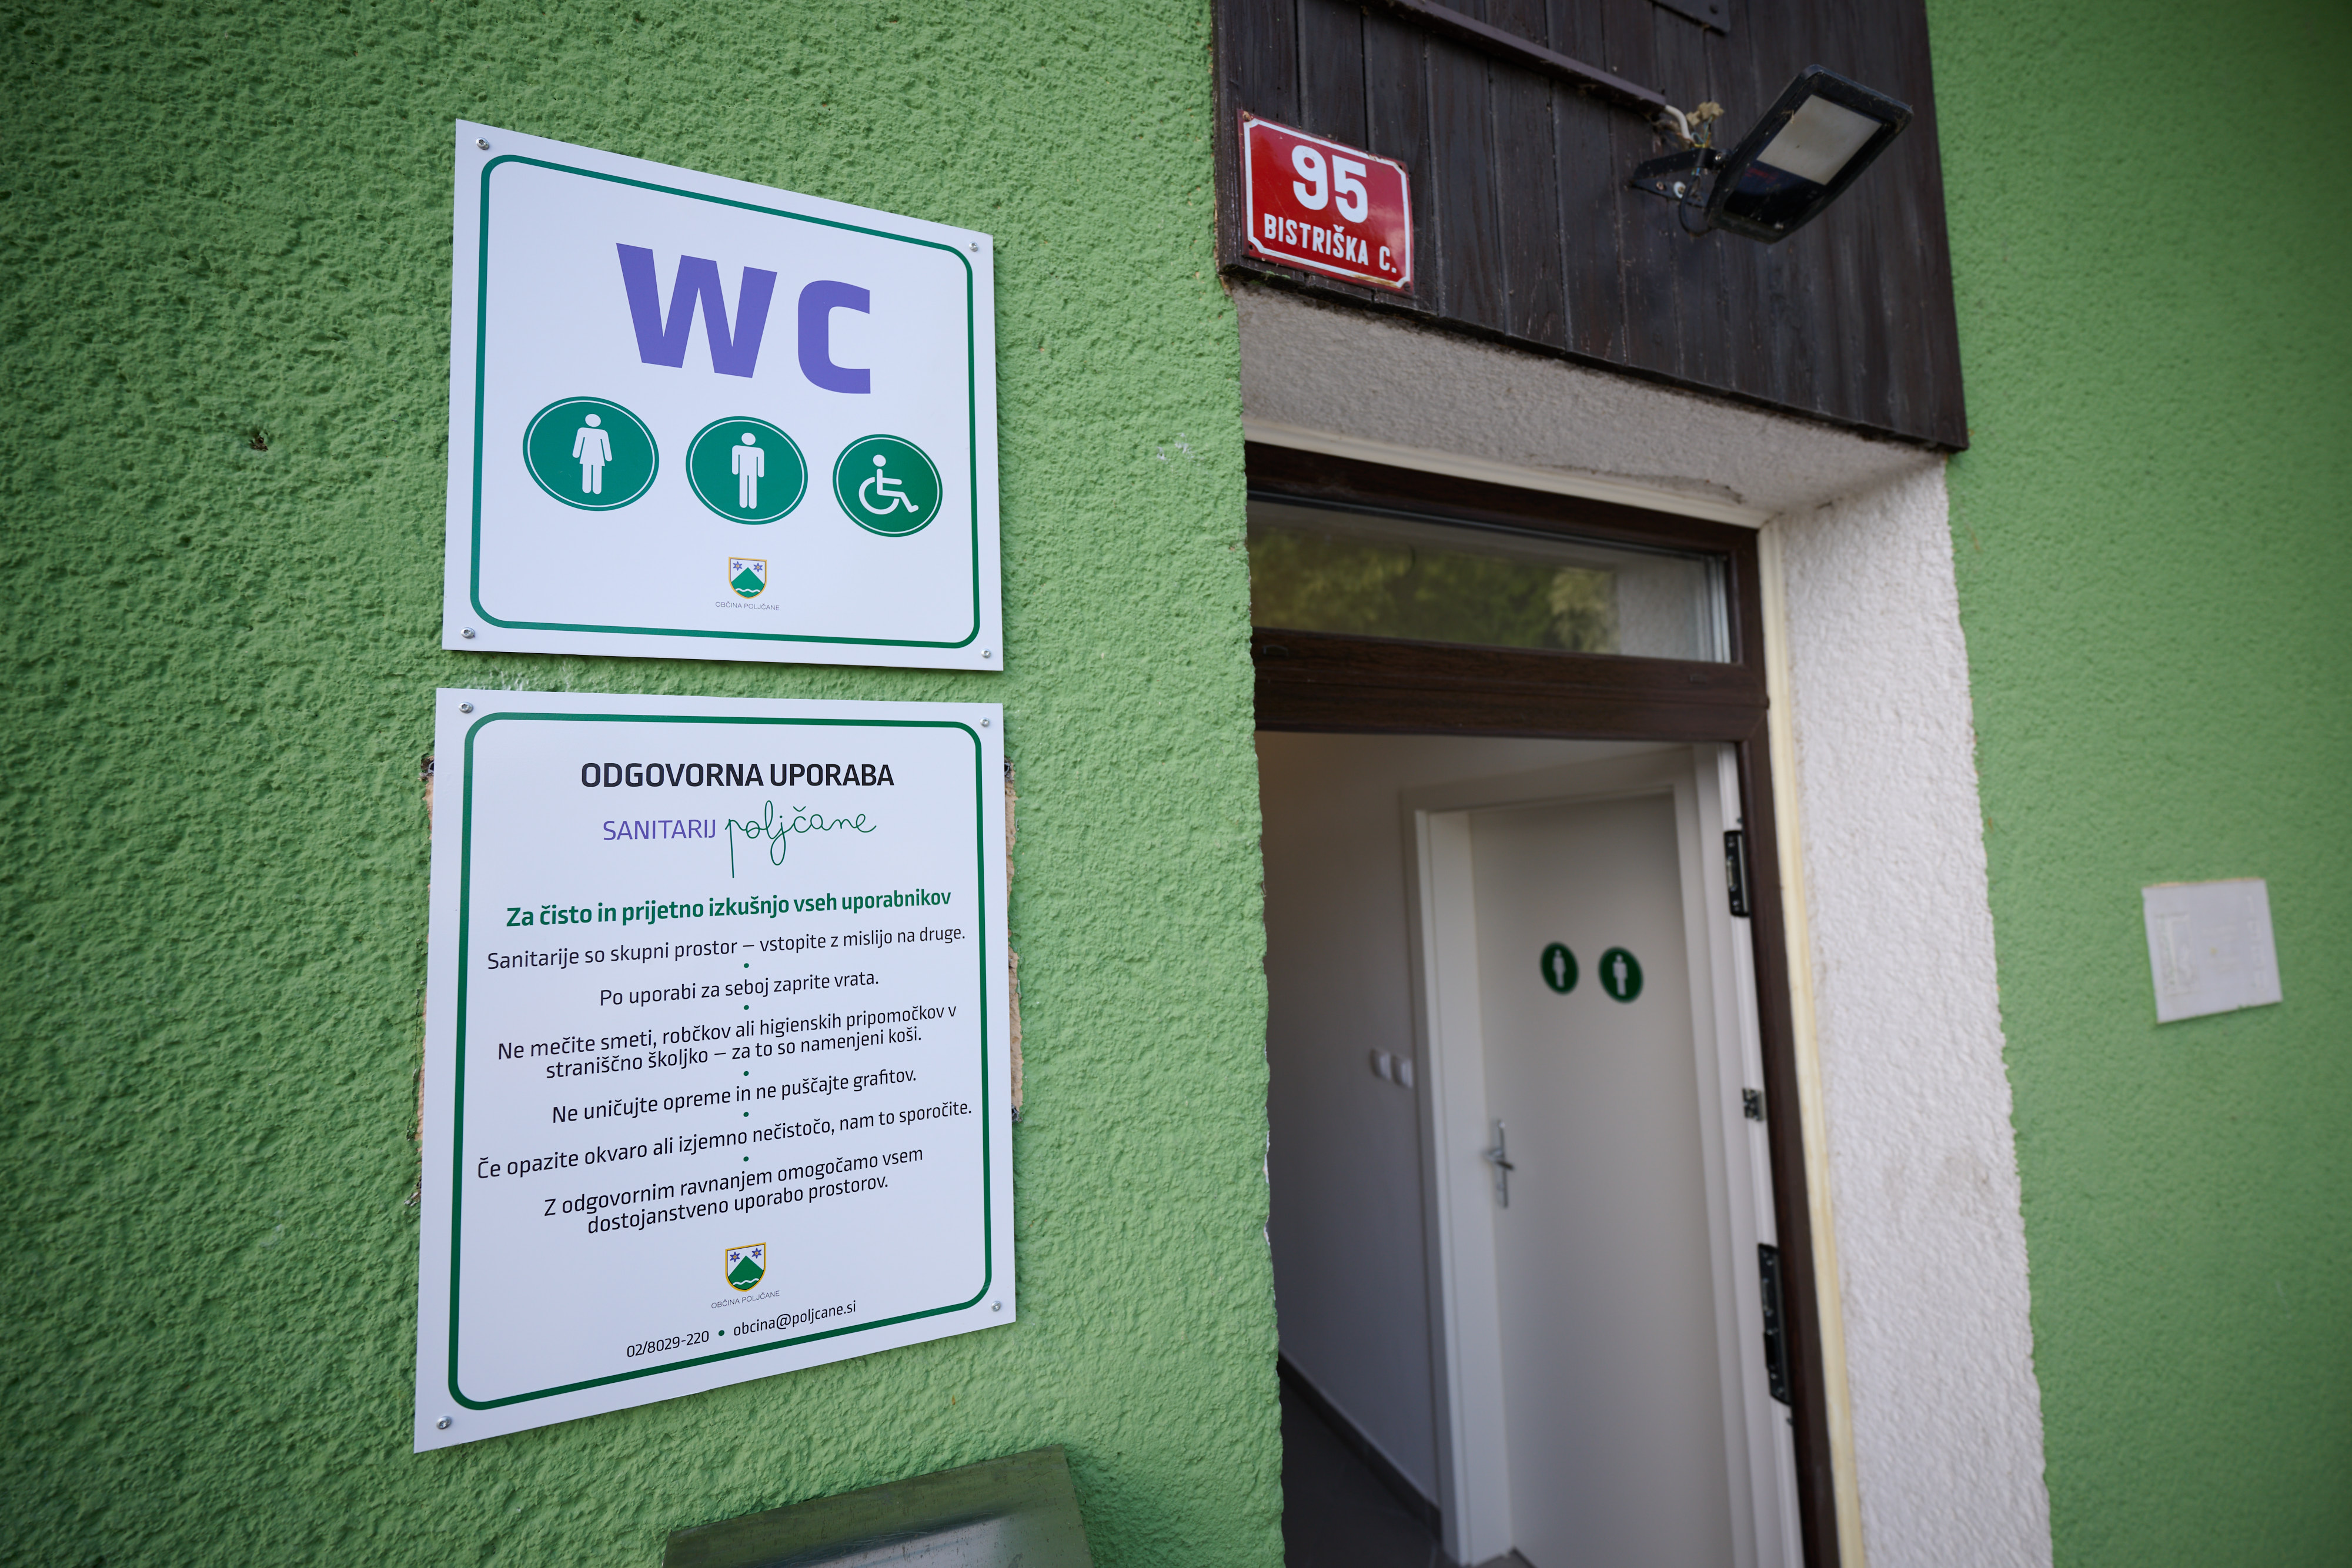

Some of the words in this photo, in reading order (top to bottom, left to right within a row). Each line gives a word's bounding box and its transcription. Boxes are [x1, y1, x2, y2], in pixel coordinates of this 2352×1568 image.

[1291, 145, 1368, 223] 95
[1264, 213, 1369, 266] BISTRIŠKA
[1379, 246, 1396, 273] C.
[616, 243, 871, 394] WC
[582, 763, 764, 787] ODGOVORNA
[771, 764, 894, 786] UPORABA
[604, 820, 715, 840] SANITARIJ
[725, 800, 876, 878] poljčane
[507, 908, 533, 927] Za
[540, 905, 592, 925] čisto
[599, 902, 616, 922] in
[623, 900, 703, 925] prijetno
[710, 895, 789, 918] izkušnjo
[794, 893, 837, 912] vseh
[842, 888, 951, 914] uporabnikov
[488, 948, 579, 969] Sanitarije
[585, 951, 604, 963] so
[611, 942, 669, 963] skupni
[676, 941, 737, 961] prostor
[760, 934, 826, 953] vstopite
[831, 937, 838, 947] z
[844, 930, 892, 948] mislijo
[898, 932, 914, 942] na
[920, 927, 964, 943] druge.
[601, 990, 622, 1005] Po
[630, 983, 696, 1007] uporabi
[701, 985, 719, 998] za
[726, 978, 768, 997] seboj
[774, 974, 829, 994] zaprite
[834, 972, 878, 987] vrata.
[499, 1043, 524, 1059] Ne
[532, 1037, 594, 1057] mečite
[602, 1029, 656, 1049] smeti,
[663, 1025, 731, 1044] robčkov
[736, 1021, 754, 1037] ali
[761, 1014, 841, 1037] higienskih
[847, 1005, 944, 1032] pripomočkov
[948, 1007, 956, 1017] v
[547, 1055, 642, 1078] straniščno
[649, 1048, 707, 1069] školjko
[732, 1047, 750, 1059] za
[756, 1043, 772, 1057] to
[778, 1042, 795, 1055] so
[801, 1029, 883, 1052] namenjeni
[889, 1027, 921, 1043] koši.
[553, 1106, 577, 1123] Ne
[584, 1097, 657, 1119] uničujte
[664, 1091, 730, 1113] opreme
[737, 1086, 750, 1101] in
[757, 1086, 776, 1099] ne
[782, 1076, 848, 1100] puščajte
[854, 1069, 916, 1091] grafitov.
[478, 1157, 500, 1178] Če
[508, 1152, 578, 1178] opazite
[585, 1145, 647, 1164] okvaro
[654, 1137, 673, 1155] ali
[680, 1132, 747, 1155] izjemno
[754, 1119, 834, 1142] nečistočo,
[840, 1116, 873, 1131] nam
[878, 1112, 894, 1125] to
[900, 1102, 971, 1125] sporočite.
[544, 1199, 556, 1216] Z
[563, 1183, 674, 1214] odgovornim
[681, 1171, 771, 1193] ravnanjem
[779, 1156, 877, 1180] omogočamo
[883, 1149, 922, 1165] vsem
[588, 1199, 728, 1233] dostojanstveno
[735, 1188, 803, 1213] uporabo
[810, 1176, 887, 1203] prostorov.
[711, 1299, 739, 1308] OBČINA
[742, 1290, 780, 1303] POLJČANE
[627, 1331, 709, 1357] 02/8029-220
[734, 1300, 856, 1336] obcina@poljcane.si
